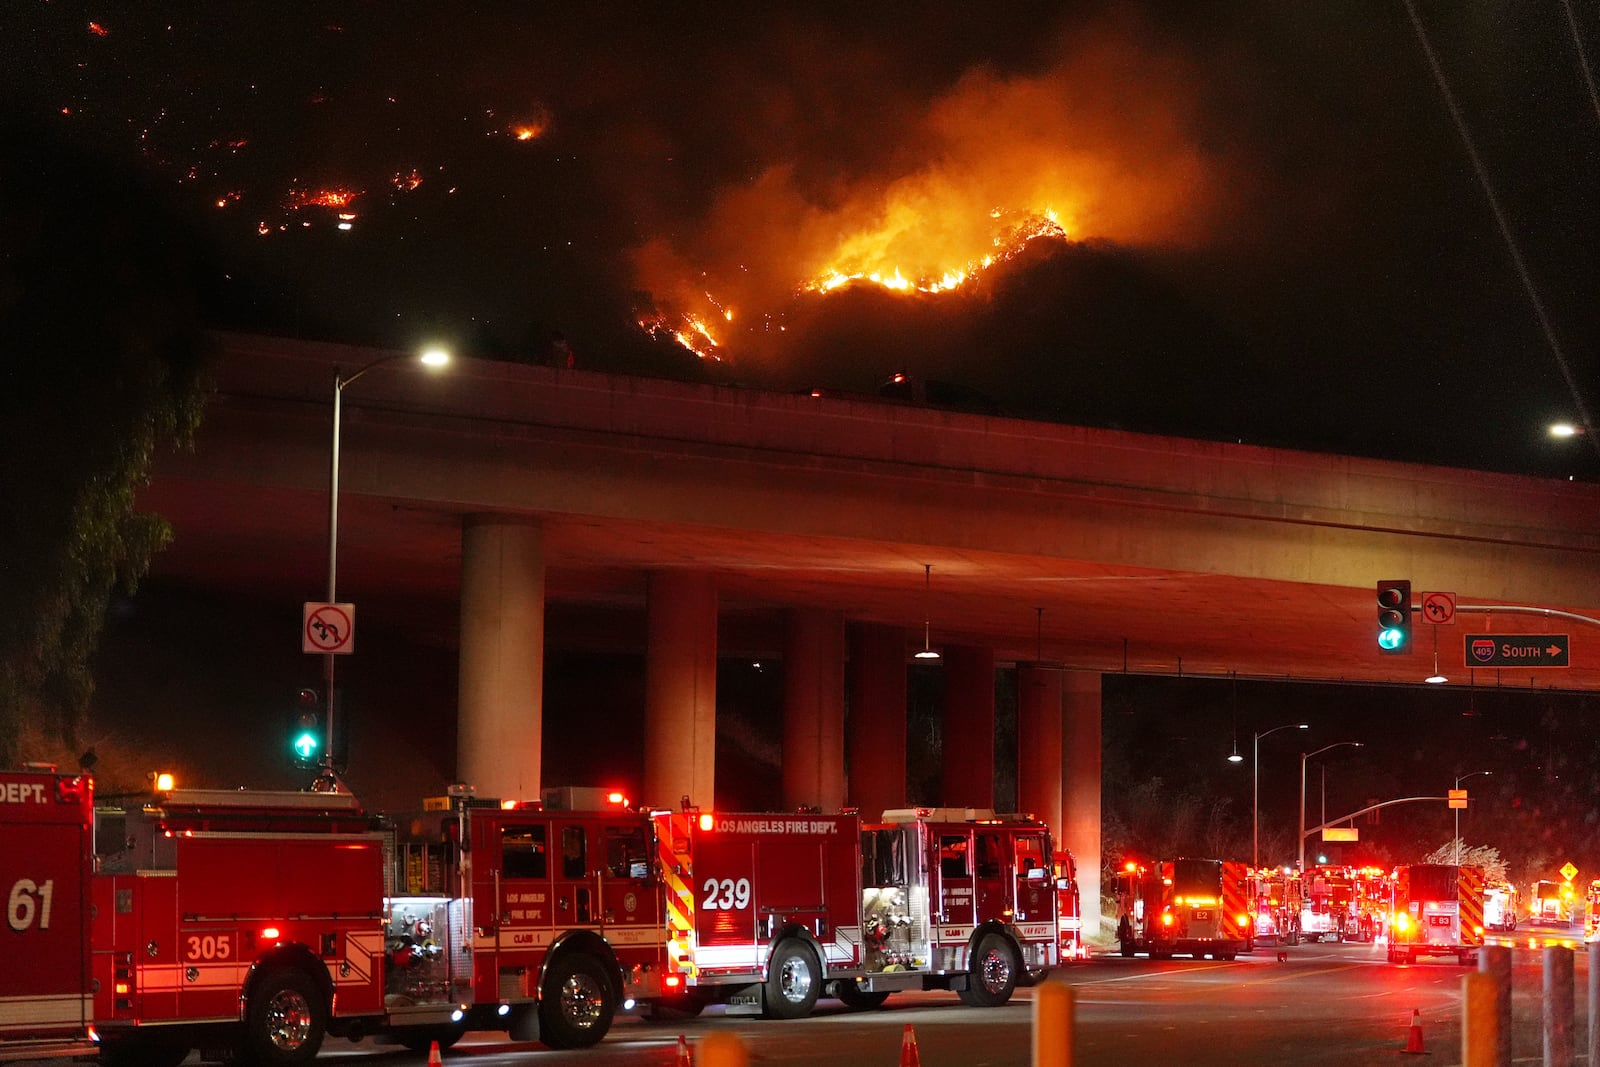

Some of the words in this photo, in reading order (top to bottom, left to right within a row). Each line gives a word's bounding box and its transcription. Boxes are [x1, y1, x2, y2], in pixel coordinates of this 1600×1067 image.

[1475, 647, 1492, 656] 405
[1502, 644, 1541, 657] SOUTH
[715, 821, 736, 833] LOS
[736, 821, 785, 833] ANGELES
[785, 821, 809, 833] FIRE
[810, 822, 838, 834] DEPT.
[702, 878, 751, 910] 239
[8, 878, 54, 931] 61
[1196, 911, 1208, 920] E2
[513, 934, 533, 943] CLASS
[187, 936, 230, 959] 305
